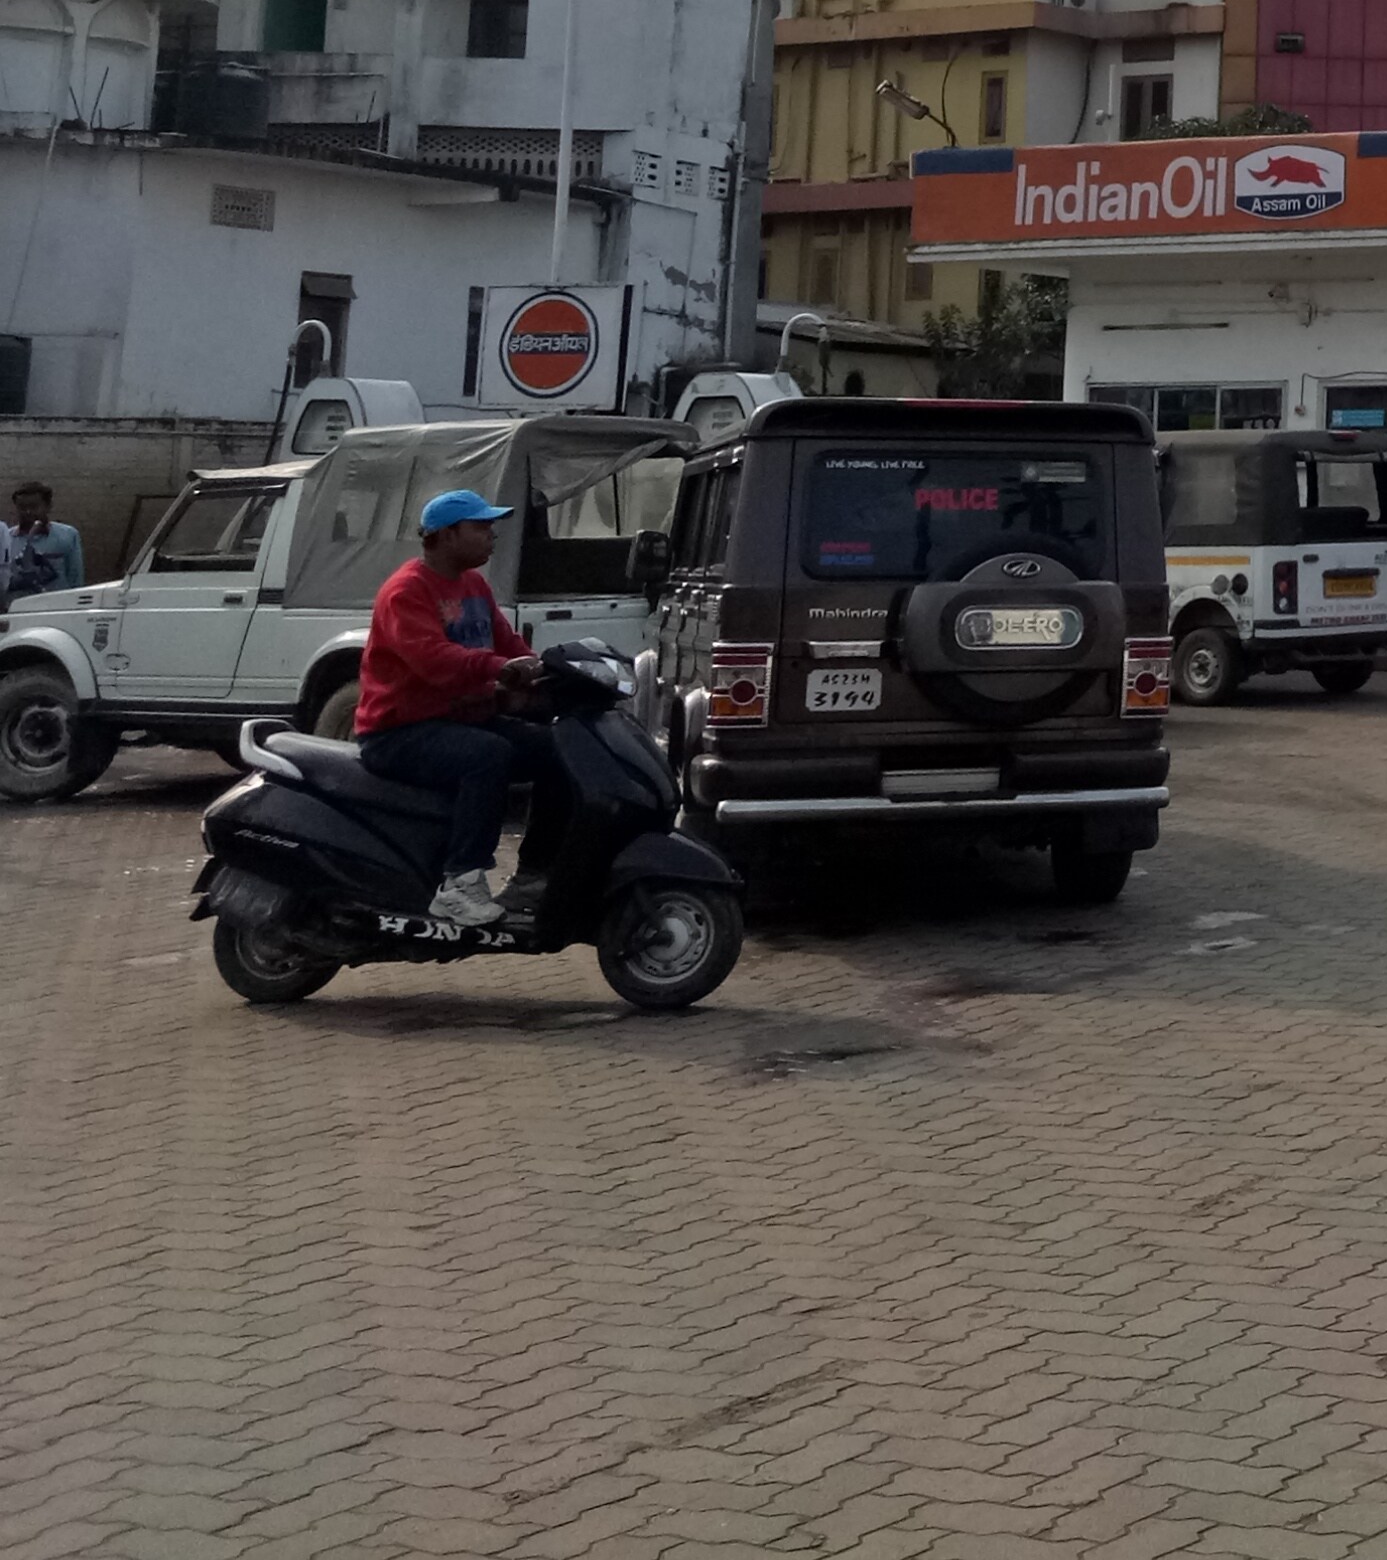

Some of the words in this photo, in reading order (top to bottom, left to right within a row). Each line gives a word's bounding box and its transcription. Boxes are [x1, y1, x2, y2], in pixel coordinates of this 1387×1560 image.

[1014, 155, 1229, 226] IndianOil
[1251, 197, 1301, 213] Assam
[1305, 194, 1326, 209] Oil
[915, 487, 999, 511] POLICE
[809, 607, 889, 619] Mahindra
